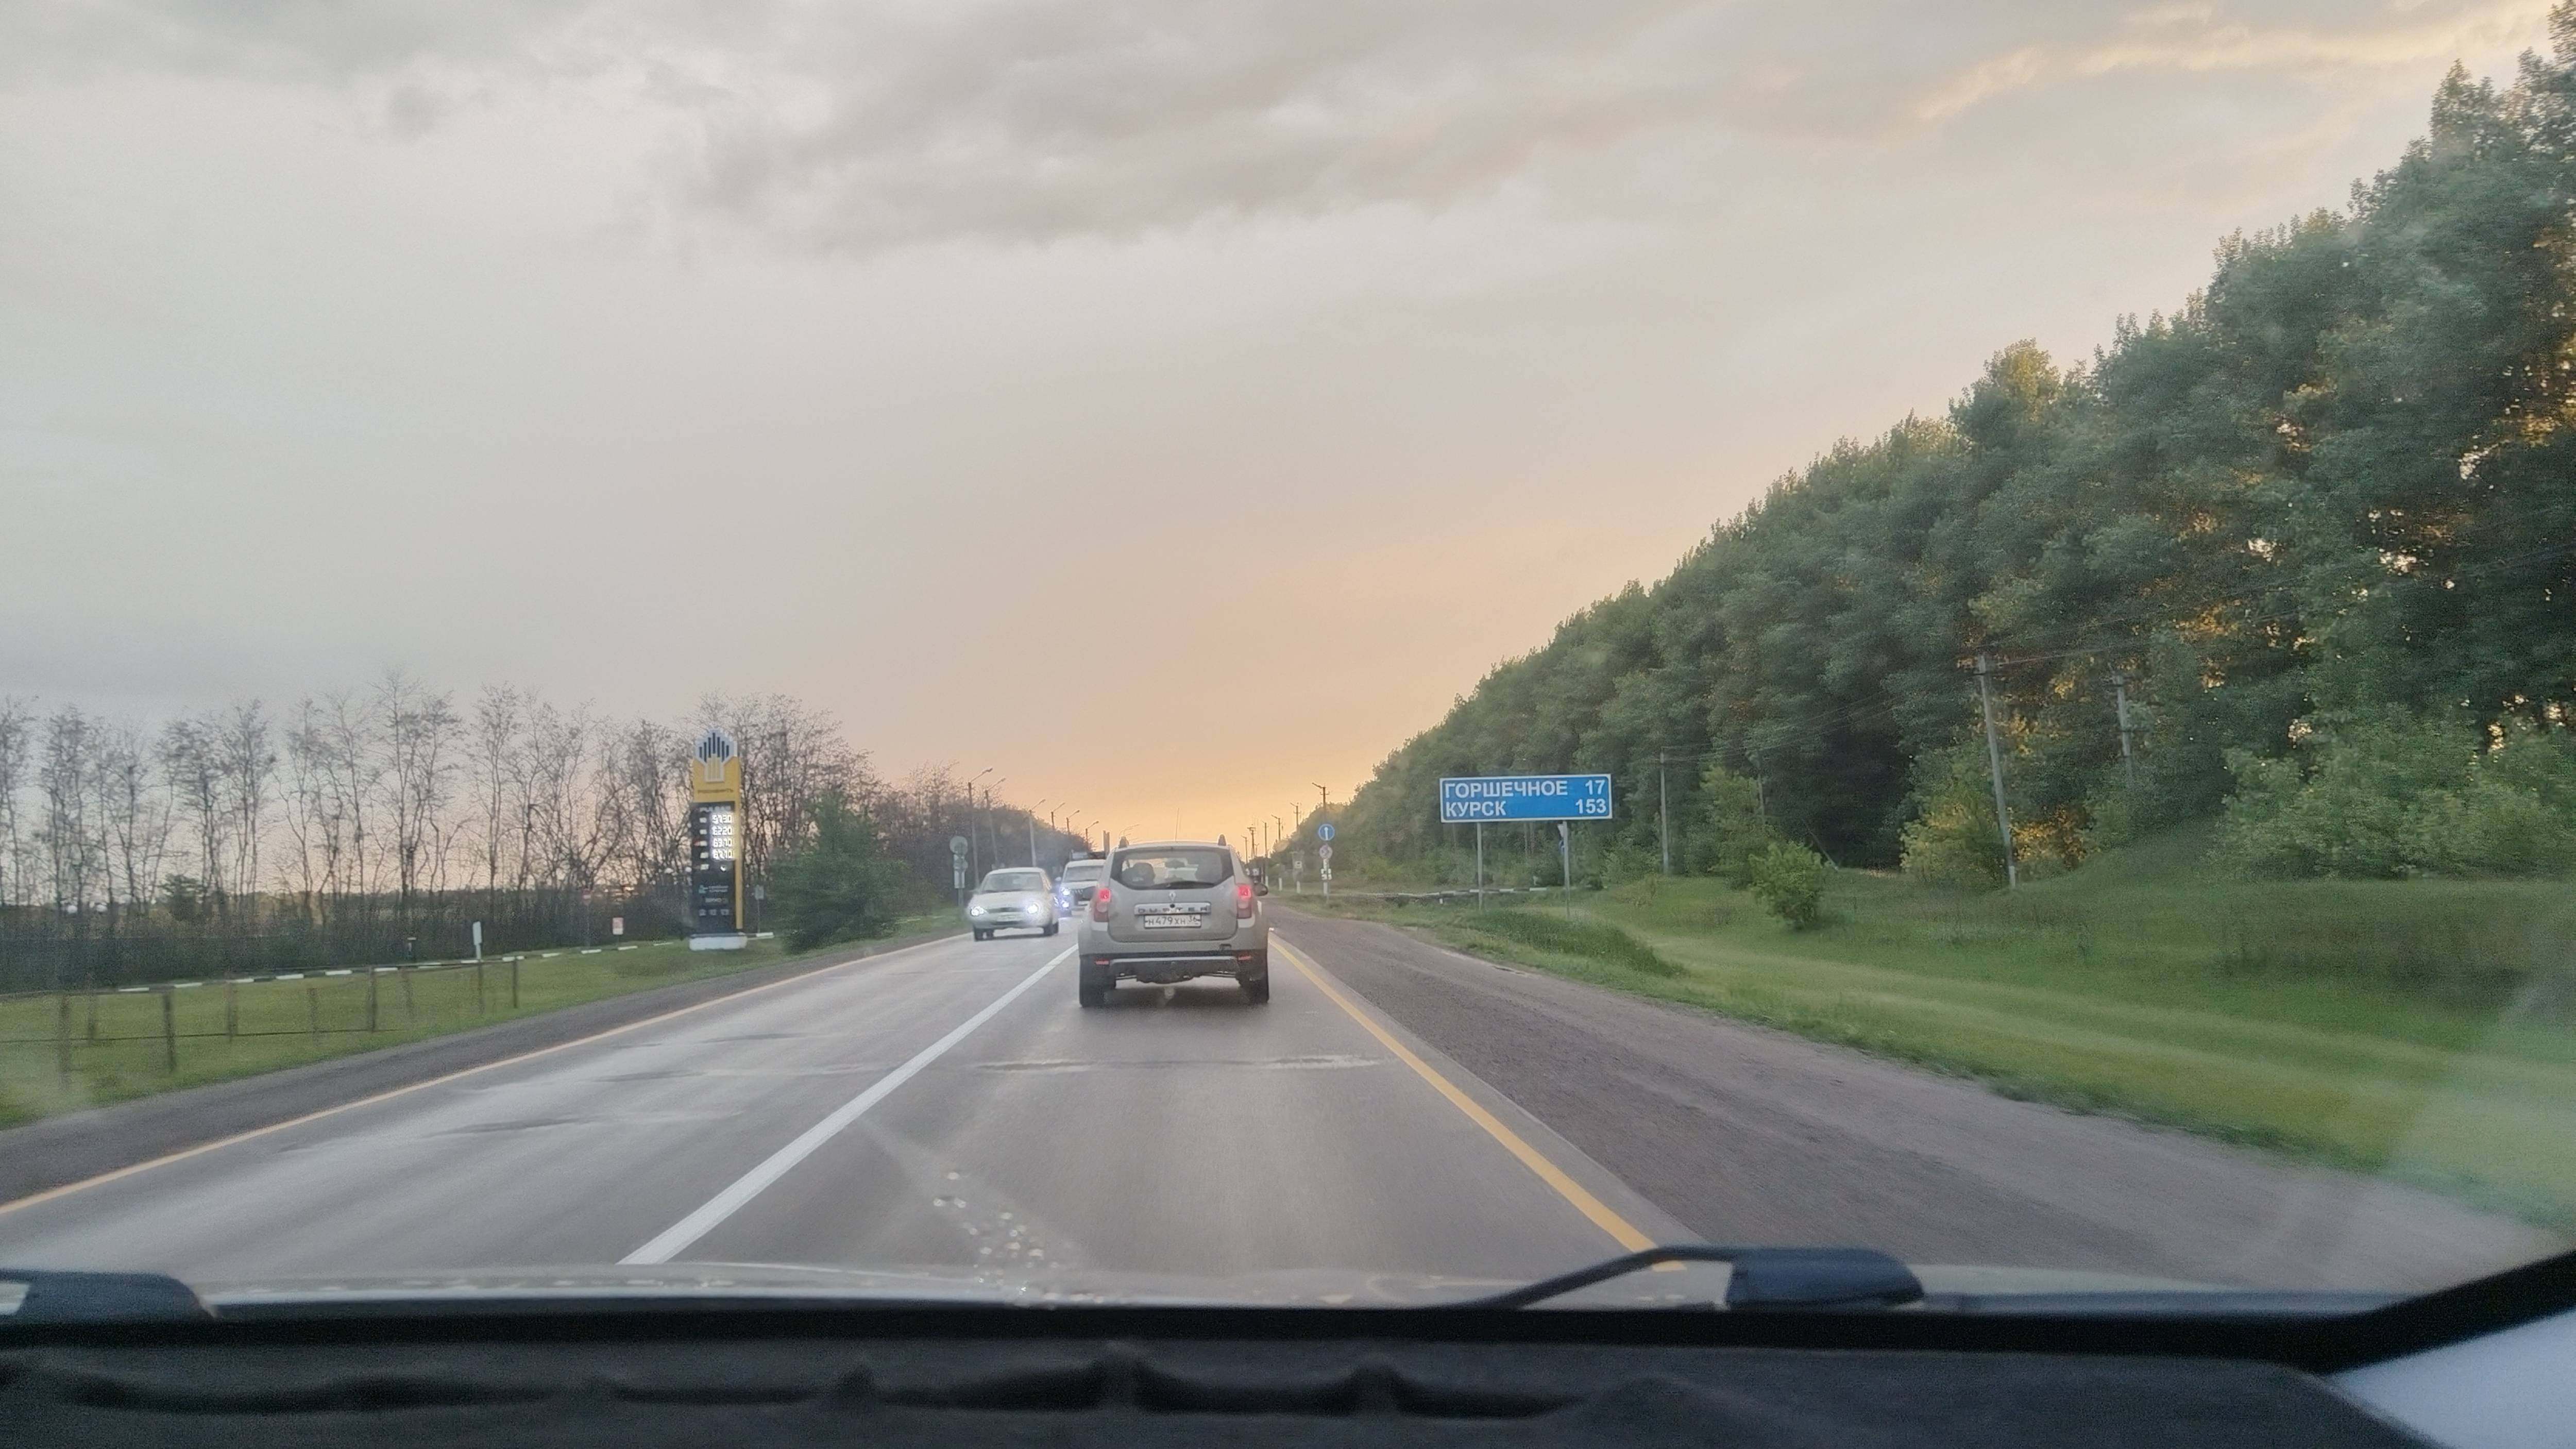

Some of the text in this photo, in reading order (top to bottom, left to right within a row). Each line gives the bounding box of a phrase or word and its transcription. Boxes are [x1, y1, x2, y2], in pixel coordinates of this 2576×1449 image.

[1445, 780, 1605, 798] ГОРШЕЧНОЕ 17
[1446, 799, 1607, 817] КУРСК 153
